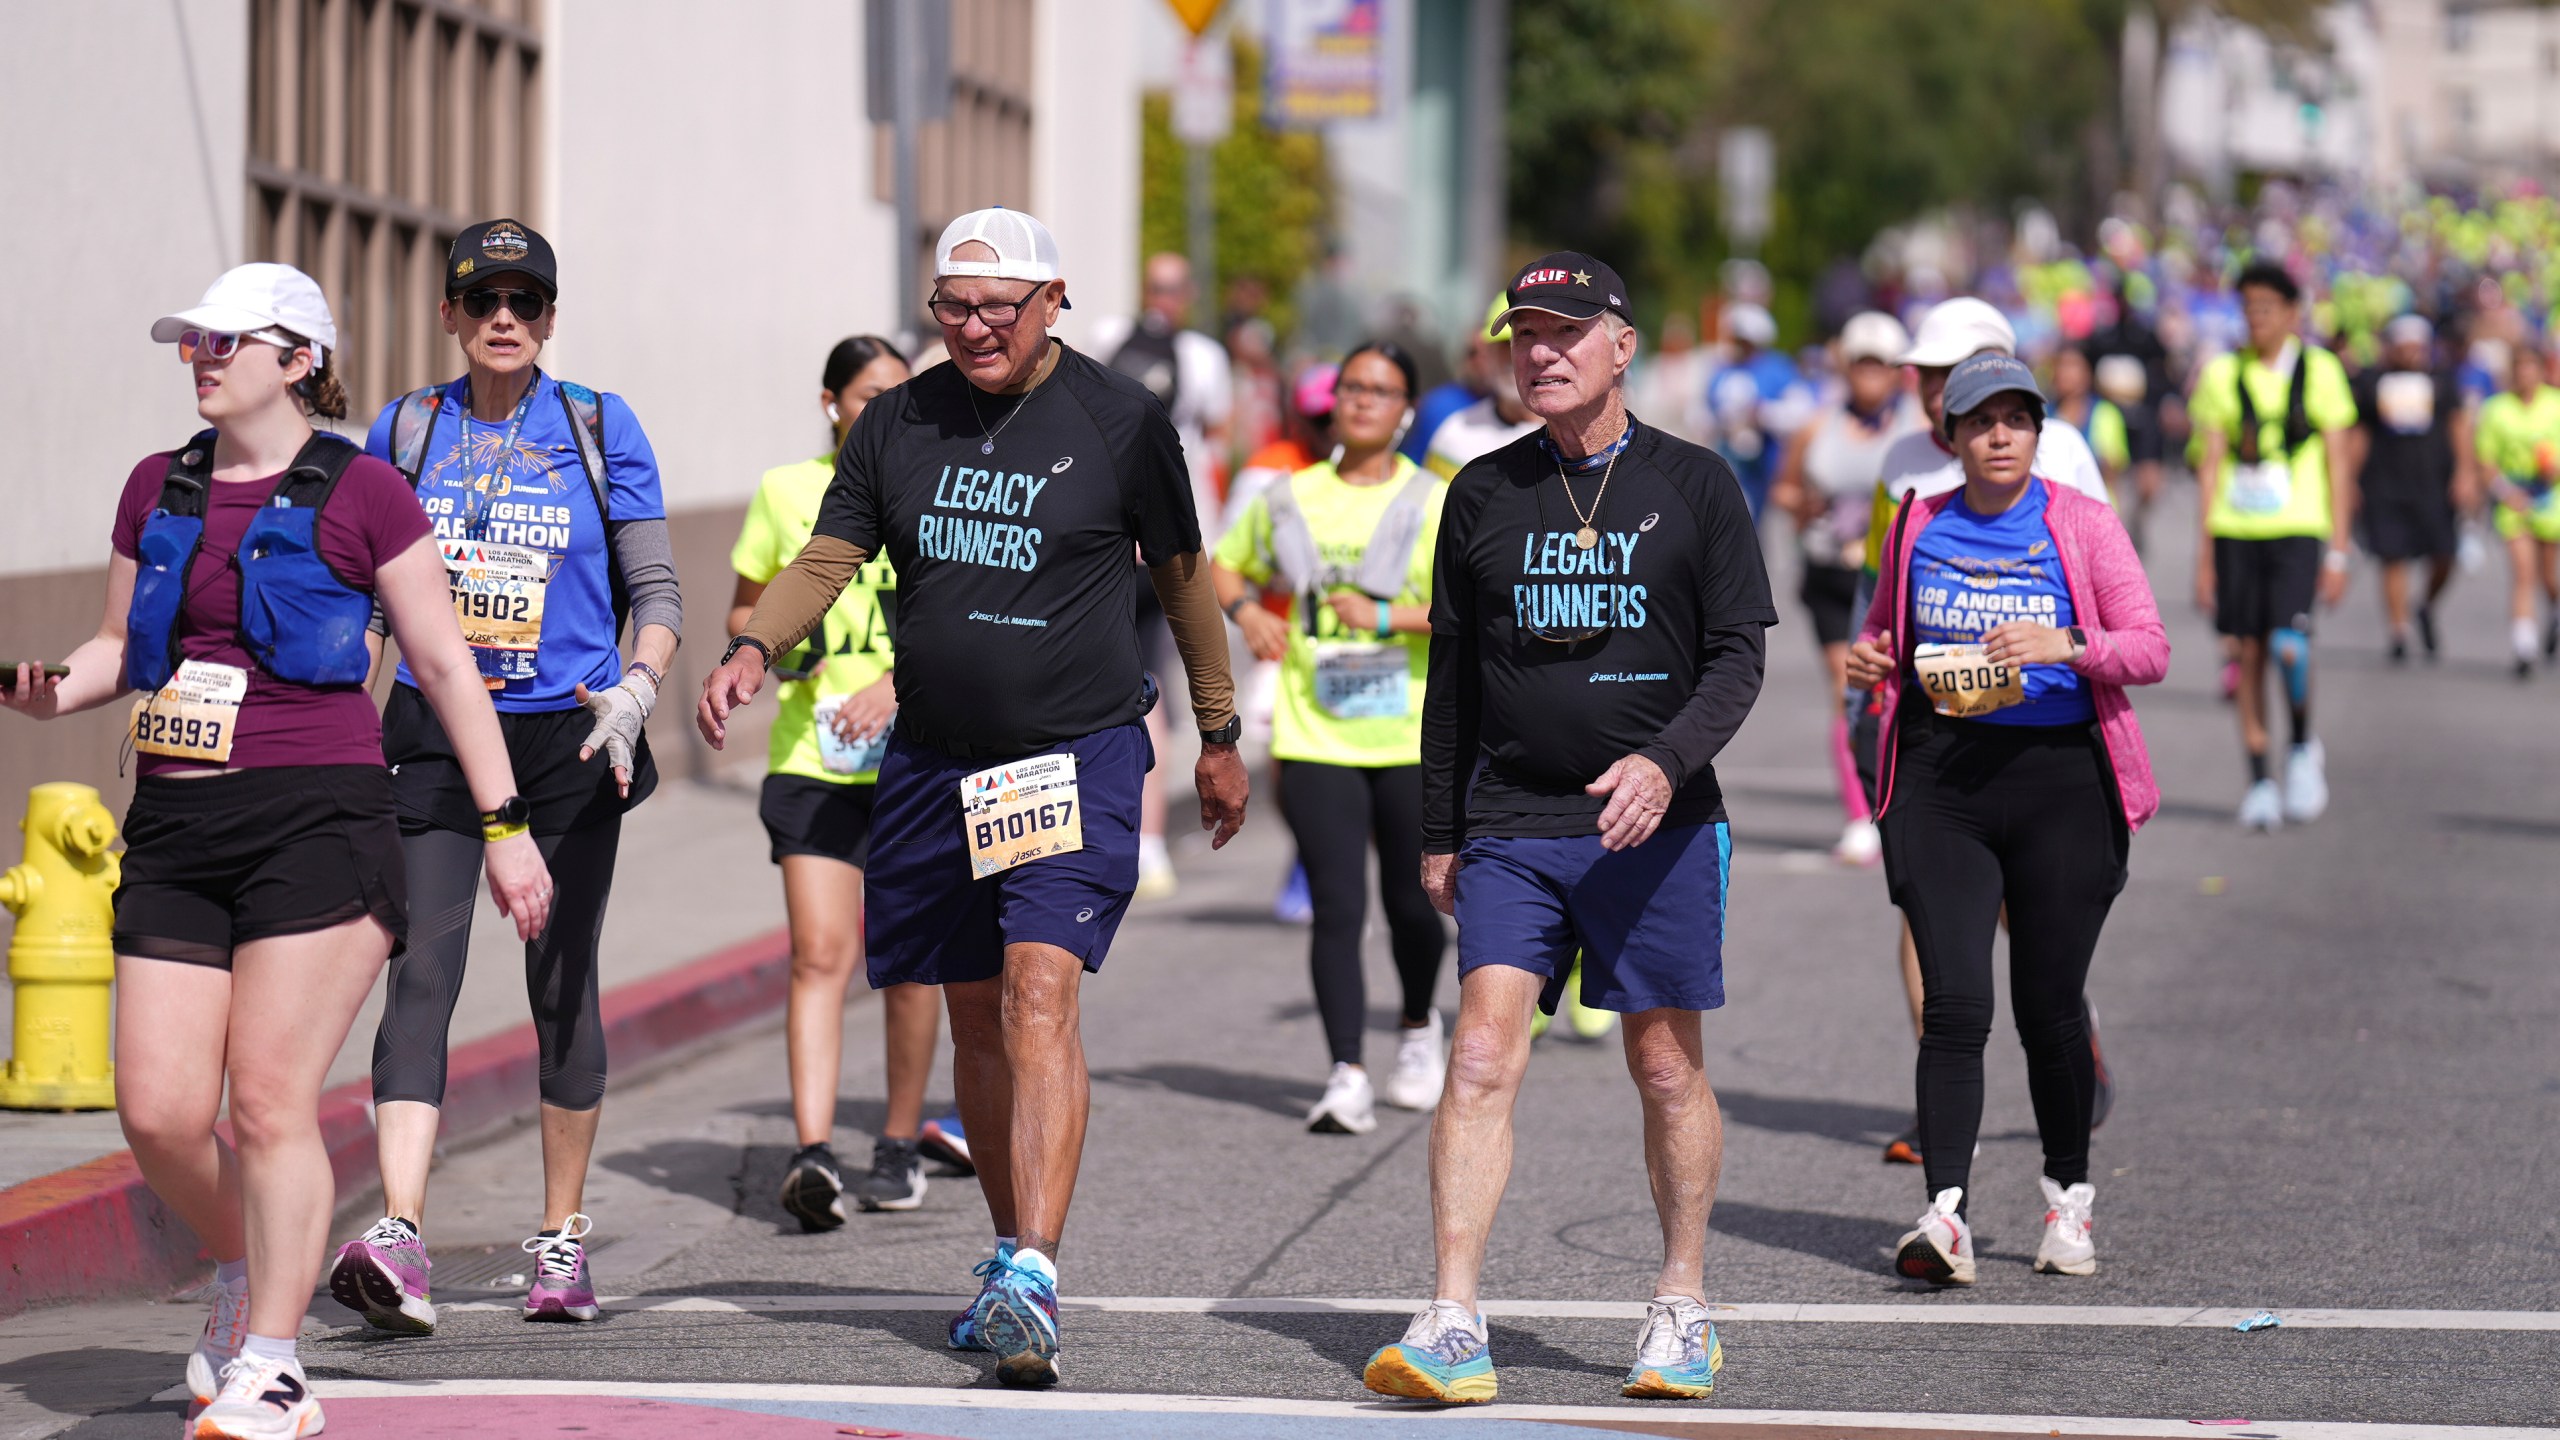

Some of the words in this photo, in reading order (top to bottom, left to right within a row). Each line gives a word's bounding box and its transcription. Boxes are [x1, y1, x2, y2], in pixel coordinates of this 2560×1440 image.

[1527, 270, 1566, 284] CLIF
[512, 484, 549, 495] RUNNING
[933, 465, 1048, 518] LEGACY
[430, 517, 570, 548] ARTHON
[918, 514, 1042, 572] RUNNERS
[488, 555, 532, 565] MARATHON
[503, 551, 533, 559] ANGELES
[1523, 532, 1640, 575] LEGACY
[466, 567, 487, 580] 40
[1513, 584, 1647, 628] RUNNERS
[1917, 585, 1948, 606] LOS
[1952, 591, 2056, 613] ANGELES
[1011, 617, 1047, 627] MARATHON
[475, 633, 499, 643] asics
[182, 674, 232, 688] MARATHON
[1598, 674, 1617, 682] asics
[1635, 673, 1669, 681] MARATHON
[1927, 666, 2010, 693] 20309
[160, 688, 179, 702] 40
[1015, 766, 1028, 774] LOS
[1030, 760, 1060, 770] ANGELES
[1016, 765, 1060, 780] MARATHON
[999, 789, 1019, 803] 40
[1017, 784, 1038, 793] YEARS
[975, 800, 1073, 850] B10167
[1020, 846, 1041, 860] asics
